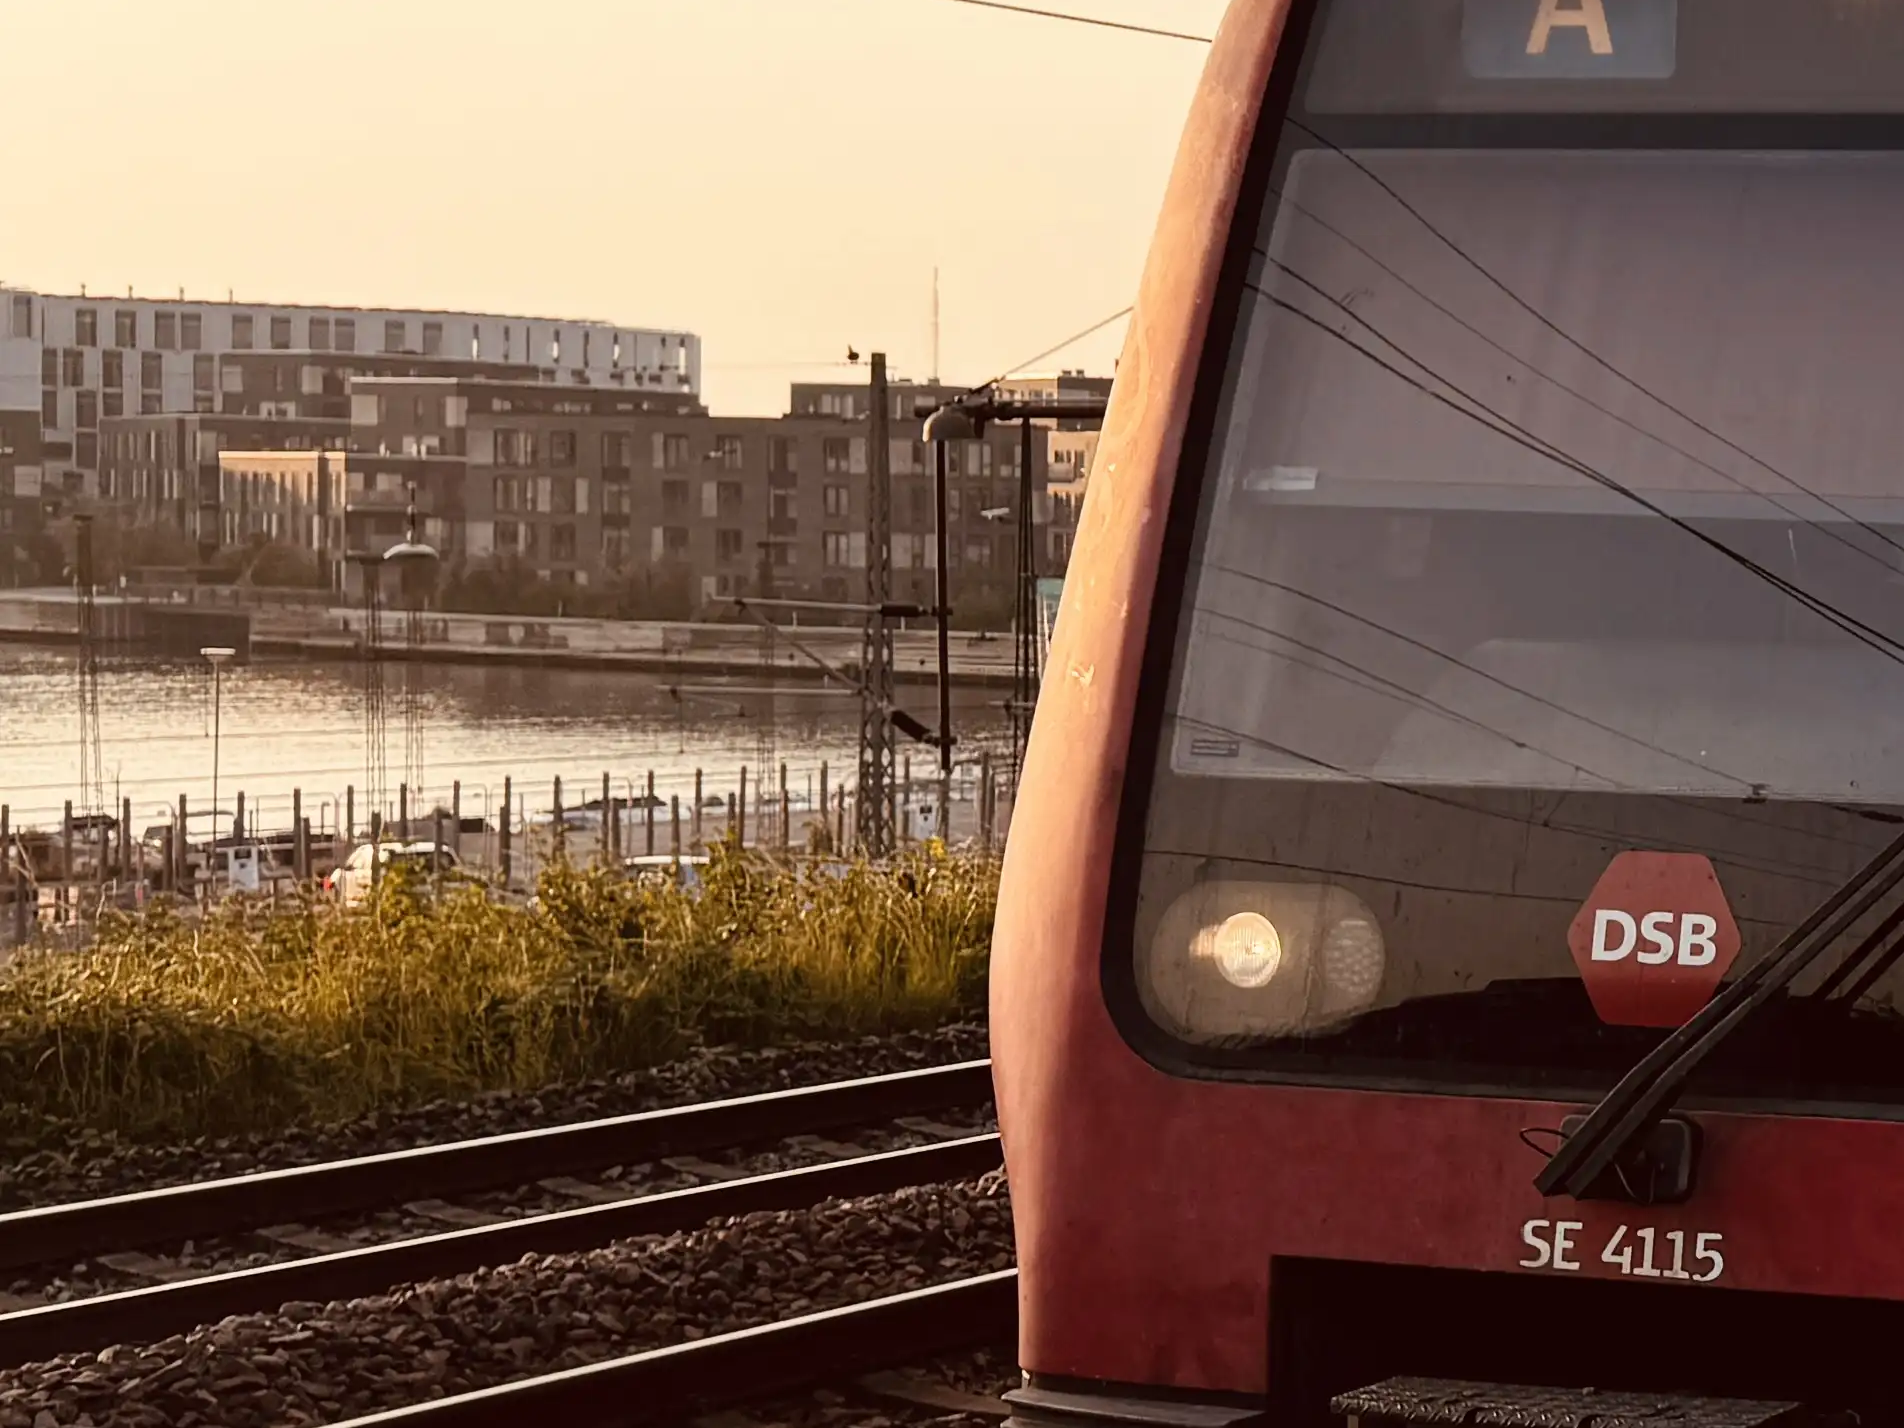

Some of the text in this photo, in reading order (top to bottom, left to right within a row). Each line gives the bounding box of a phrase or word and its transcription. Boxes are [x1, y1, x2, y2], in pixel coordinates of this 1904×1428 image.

[1591, 909, 1717, 966] DSB
[1519, 1219, 1724, 1282] SE 4115
